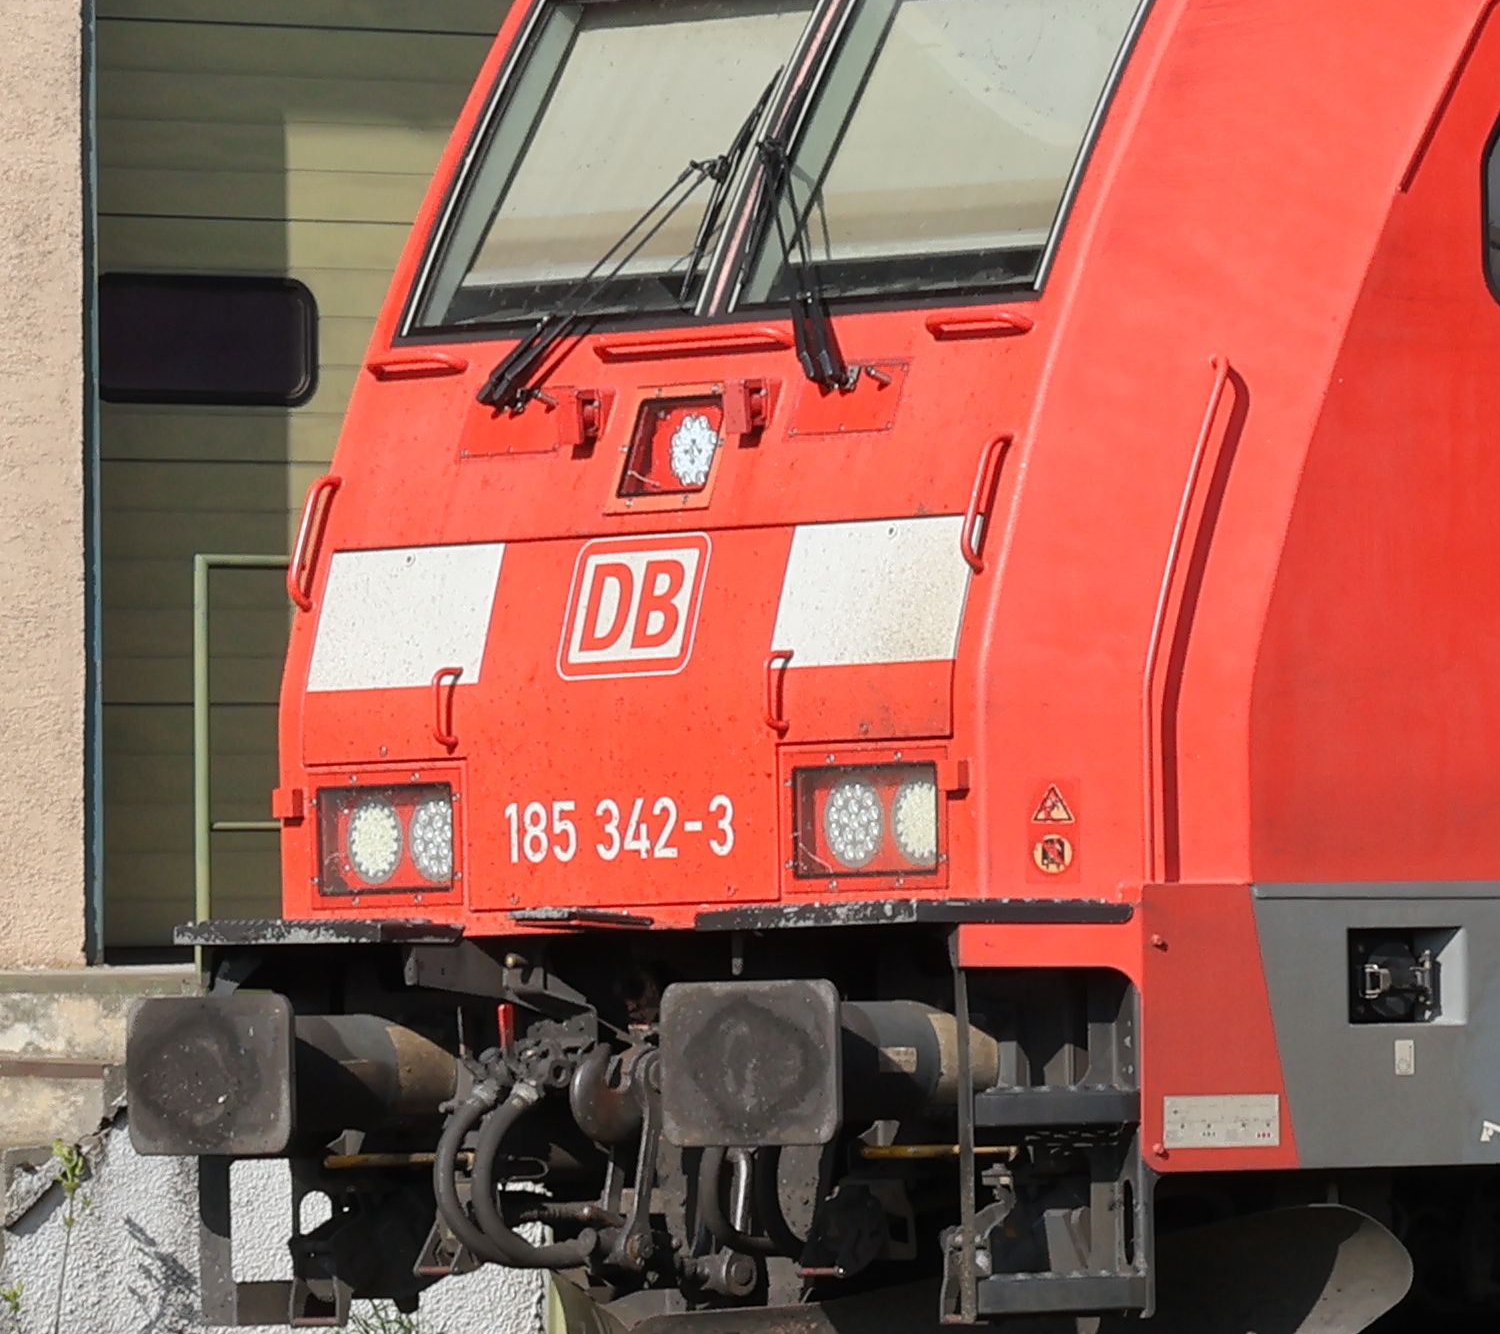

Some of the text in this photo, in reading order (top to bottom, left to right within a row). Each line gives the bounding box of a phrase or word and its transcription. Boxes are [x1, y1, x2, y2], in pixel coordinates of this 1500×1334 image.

[578, 559, 686, 653] DB
[504, 794, 735, 863] 185 342-3
